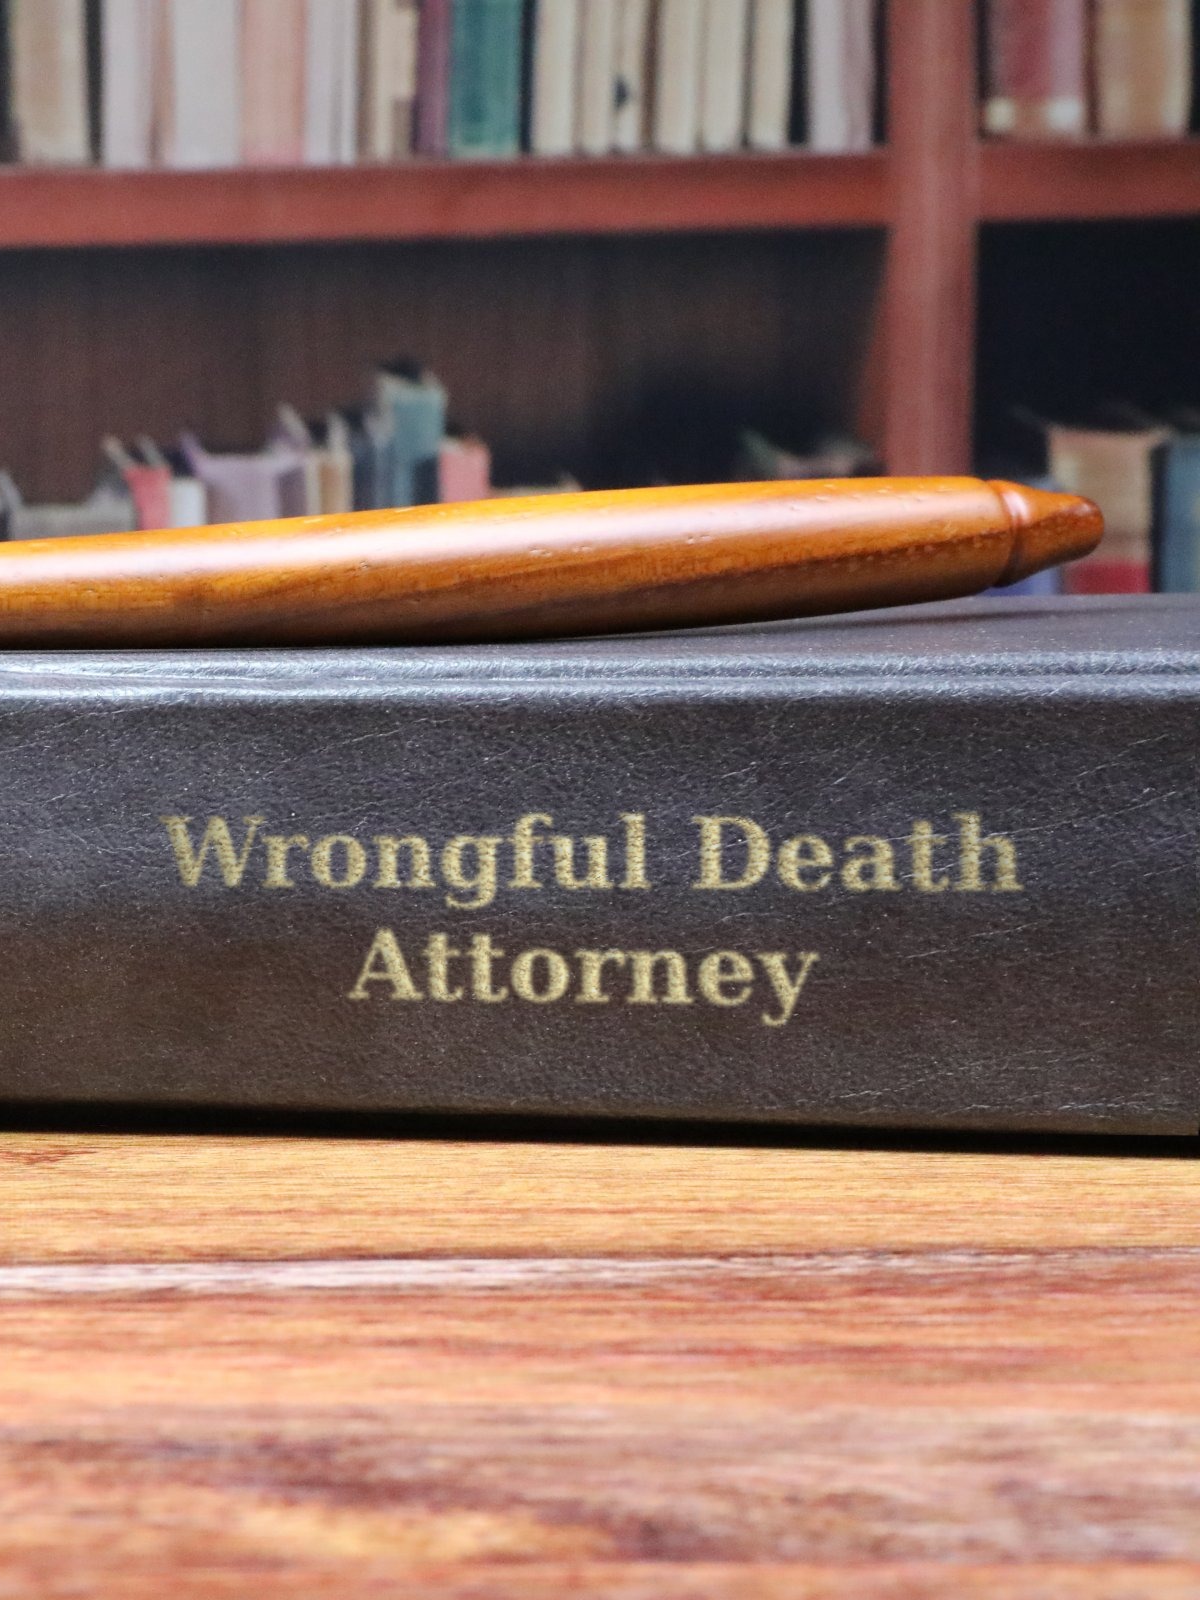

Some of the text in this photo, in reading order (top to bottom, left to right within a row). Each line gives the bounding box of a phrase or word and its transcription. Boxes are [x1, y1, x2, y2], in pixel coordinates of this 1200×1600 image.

[161, 813, 1023, 910] Wrongful Death
[346, 927, 821, 1028] Attorney
